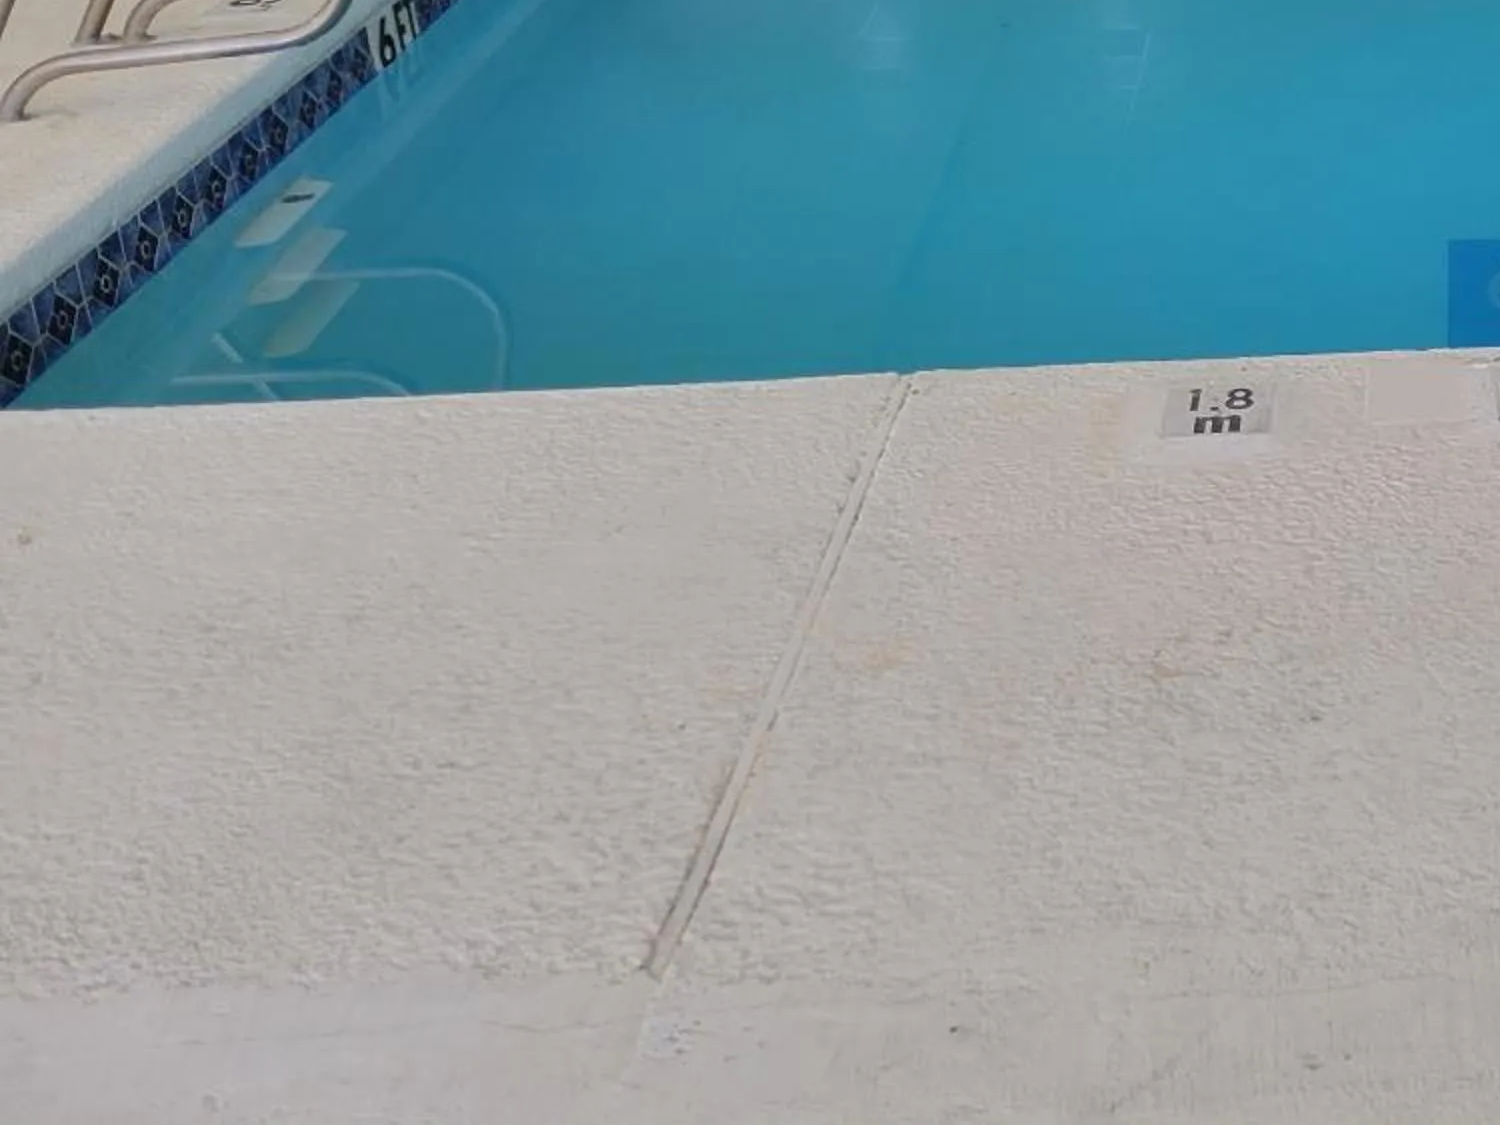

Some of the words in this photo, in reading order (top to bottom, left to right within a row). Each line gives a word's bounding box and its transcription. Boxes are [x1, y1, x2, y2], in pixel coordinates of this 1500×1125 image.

[379, 16, 397, 68] 6
[1189, 388, 1255, 412] 1.8
[1193, 414, 1242, 434] m
